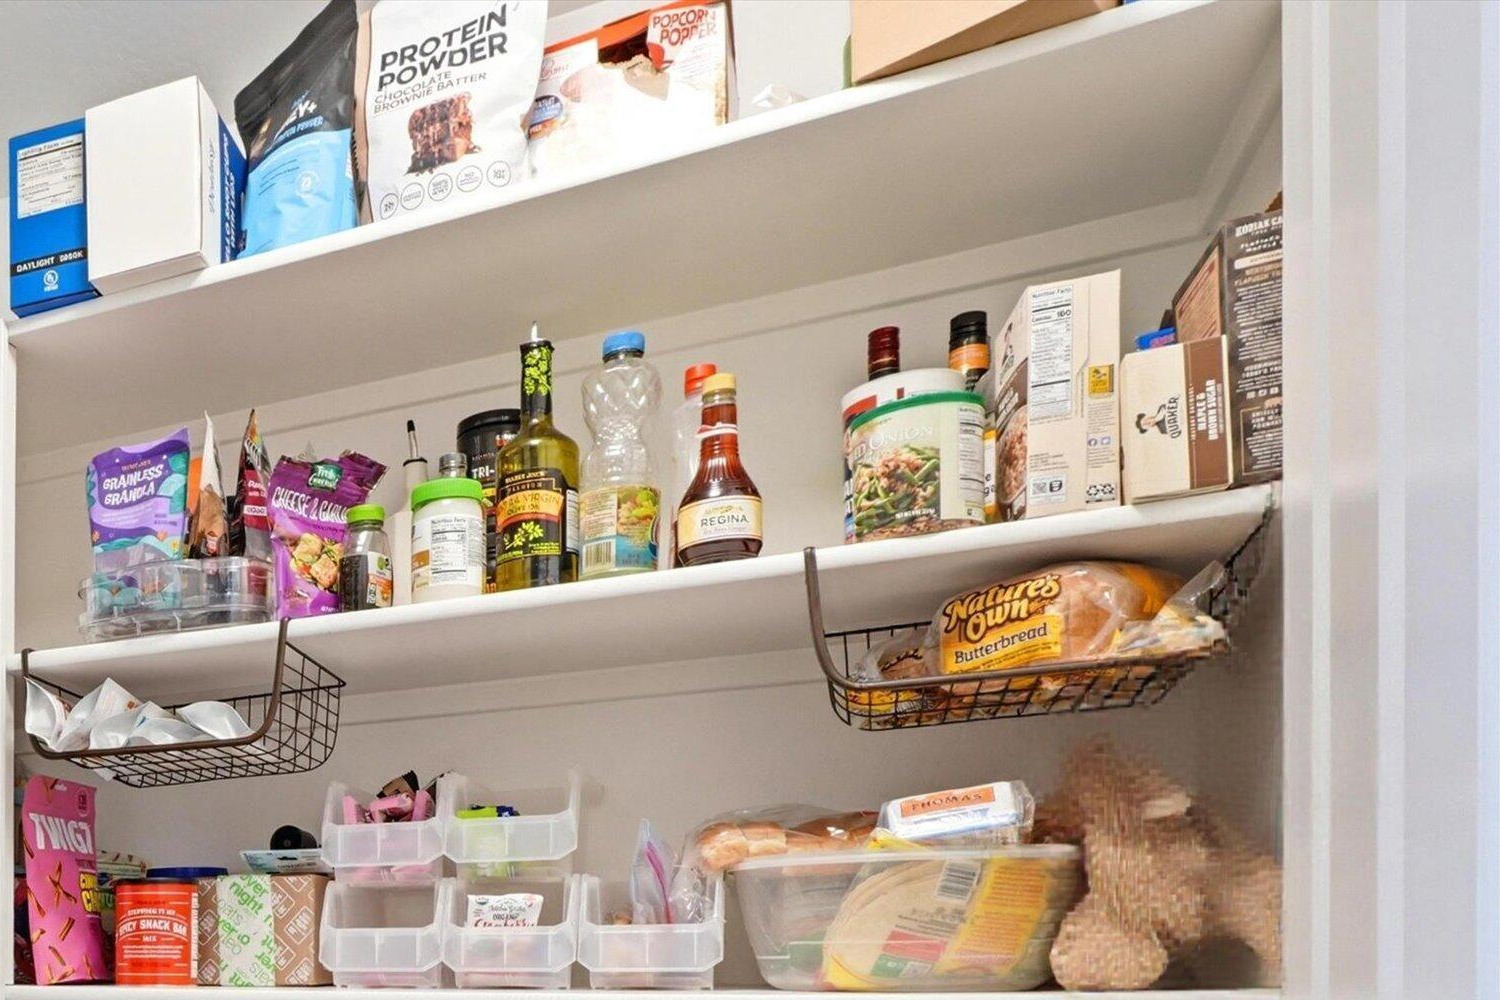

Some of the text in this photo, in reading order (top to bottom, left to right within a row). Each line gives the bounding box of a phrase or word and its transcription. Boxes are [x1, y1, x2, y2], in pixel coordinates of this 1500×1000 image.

[652, 8, 717, 29] POPCORN
[380, 3, 507, 72] PROTEIN
[660, 22, 718, 46] POPPER
[378, 32, 508, 92] POWDER
[373, 72, 488, 115] BROWNIE BATTER
[374, 71, 452, 105] CHOCOLATE
[1235, 218, 1271, 238] KODIAK
[16, 255, 55, 273] DAYLIGHT
[1205, 379, 1217, 408] SUGAR
[1170, 394, 1181, 440] QUAKER
[102, 464, 165, 491] GRAINLESS
[104, 482, 156, 506] GRANOLA
[272, 486, 310, 515] CHEESE
[700, 514, 749, 528] REGINA
[943, 573, 1062, 634] Nature's
[964, 598, 1031, 644] Own
[954, 622, 1048, 665] Butterbread
[230, 882, 264, 915] night
[139, 918, 171, 931] SNACK
